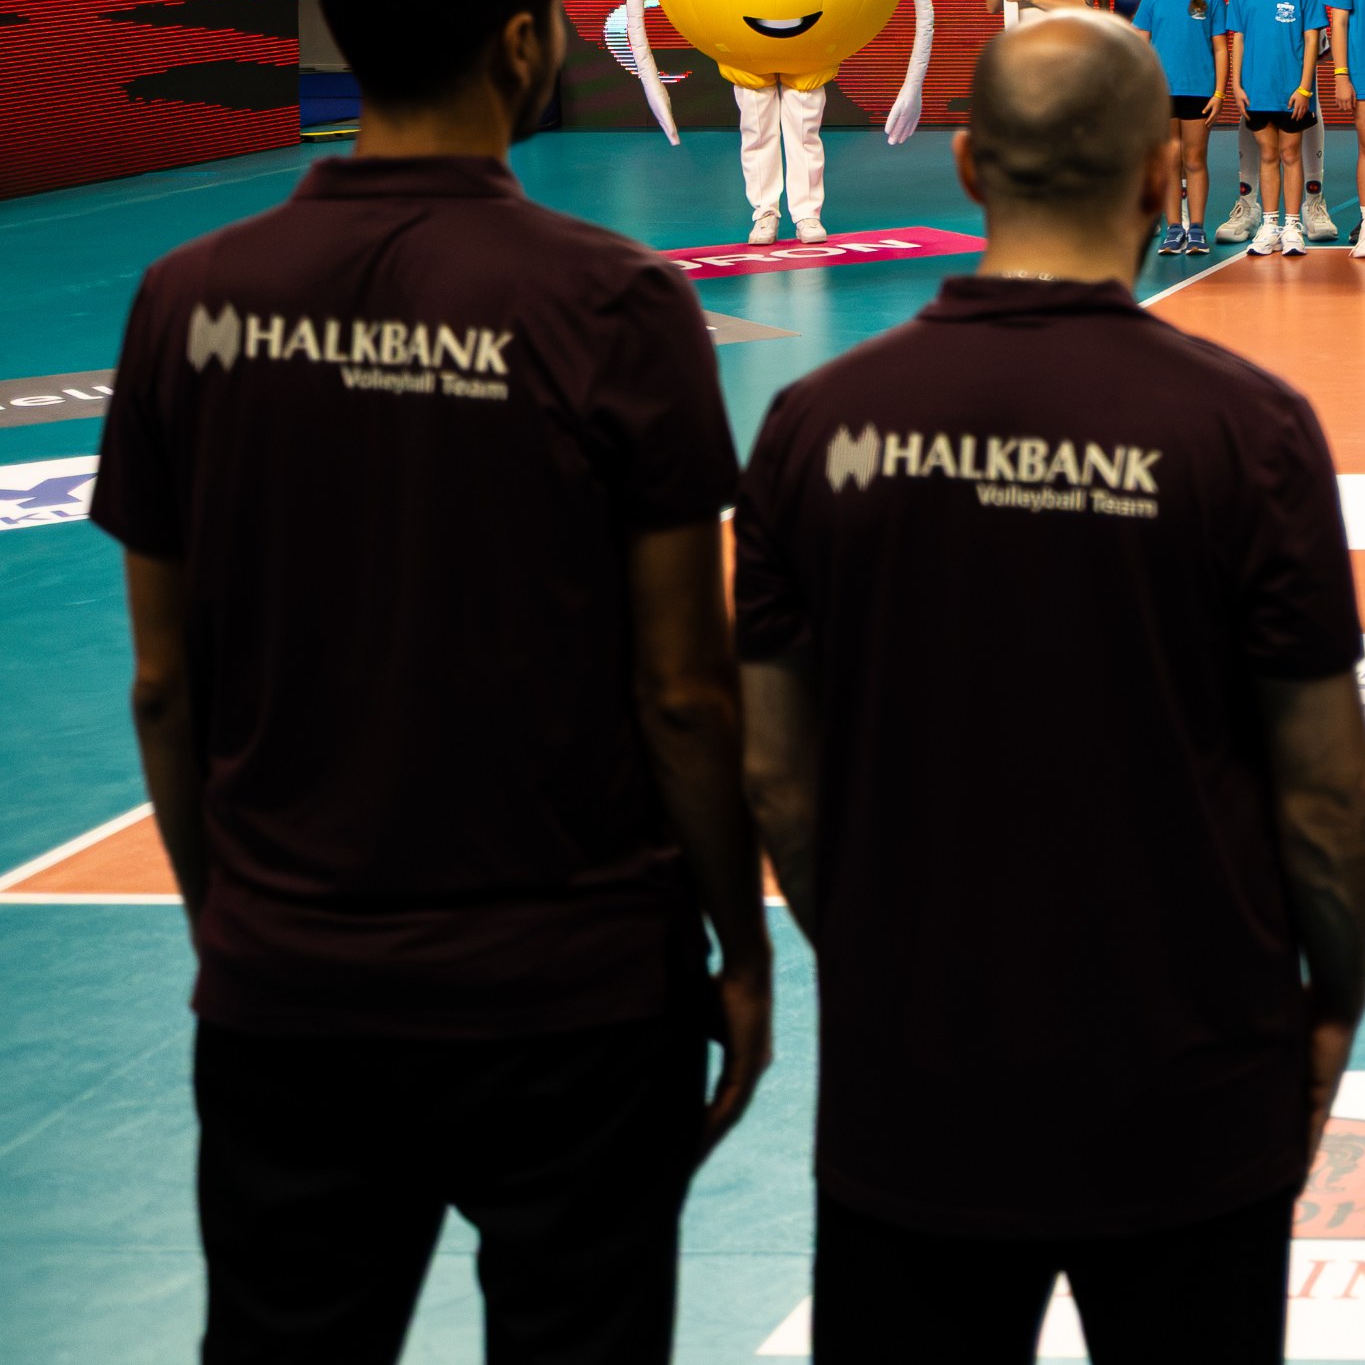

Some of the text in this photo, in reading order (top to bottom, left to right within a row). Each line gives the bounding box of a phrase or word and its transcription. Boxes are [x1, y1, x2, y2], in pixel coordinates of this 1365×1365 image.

[245, 314, 515, 376] HALKBANK
[341, 366, 510, 400] Volleyball Team
[882, 432, 1164, 495] HALKBANK
[975, 482, 1160, 521] Volleyball Team
